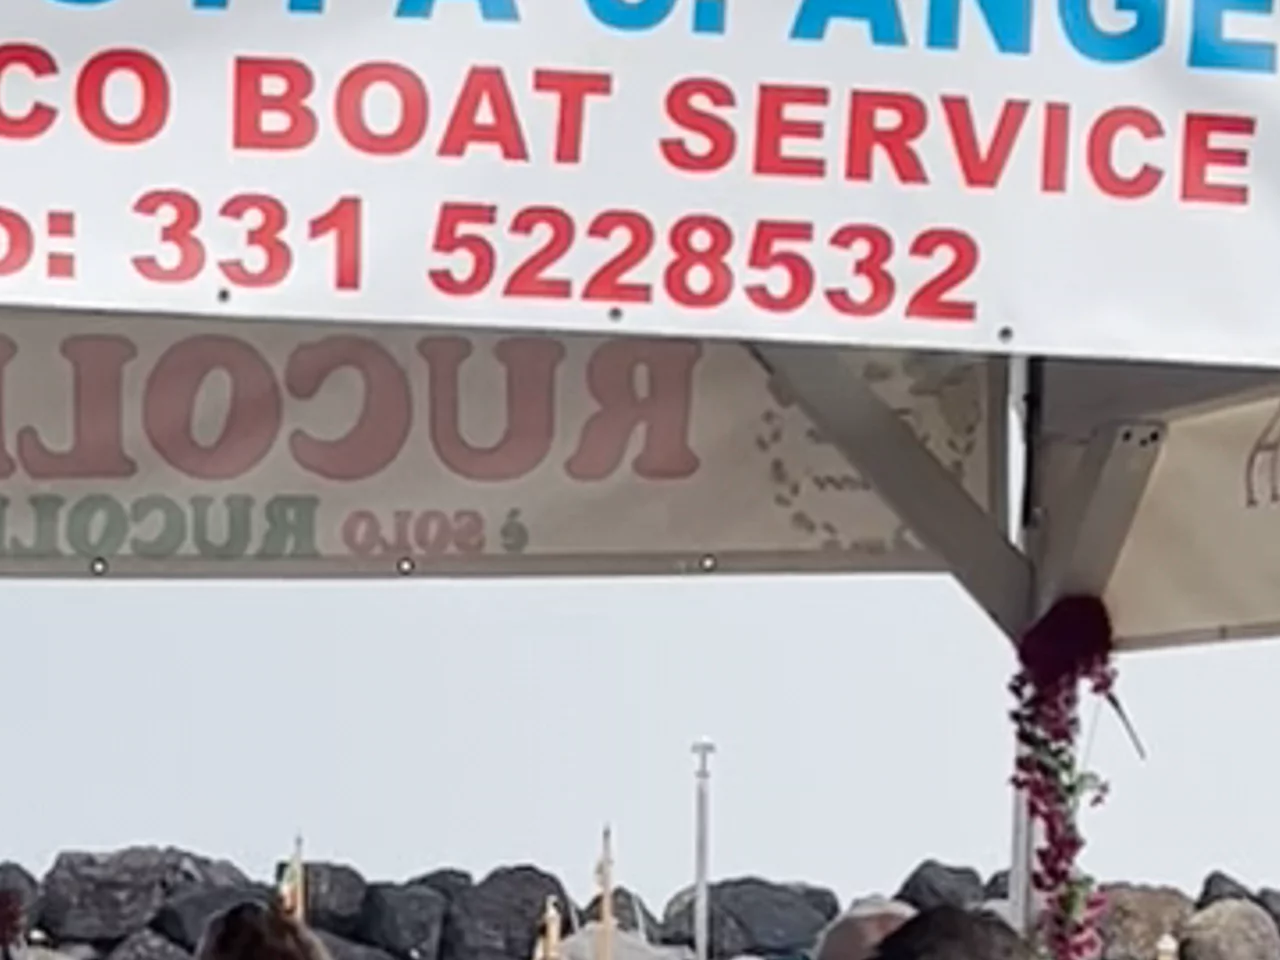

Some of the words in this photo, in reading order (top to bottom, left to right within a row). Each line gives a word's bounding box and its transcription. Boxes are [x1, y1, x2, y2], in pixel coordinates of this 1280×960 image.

[232, 58, 612, 166] BOAT
[659, 79, 1255, 205] SERVICE
[133, 191, 362, 291] 331
[428, 202, 980, 322] 5228532
